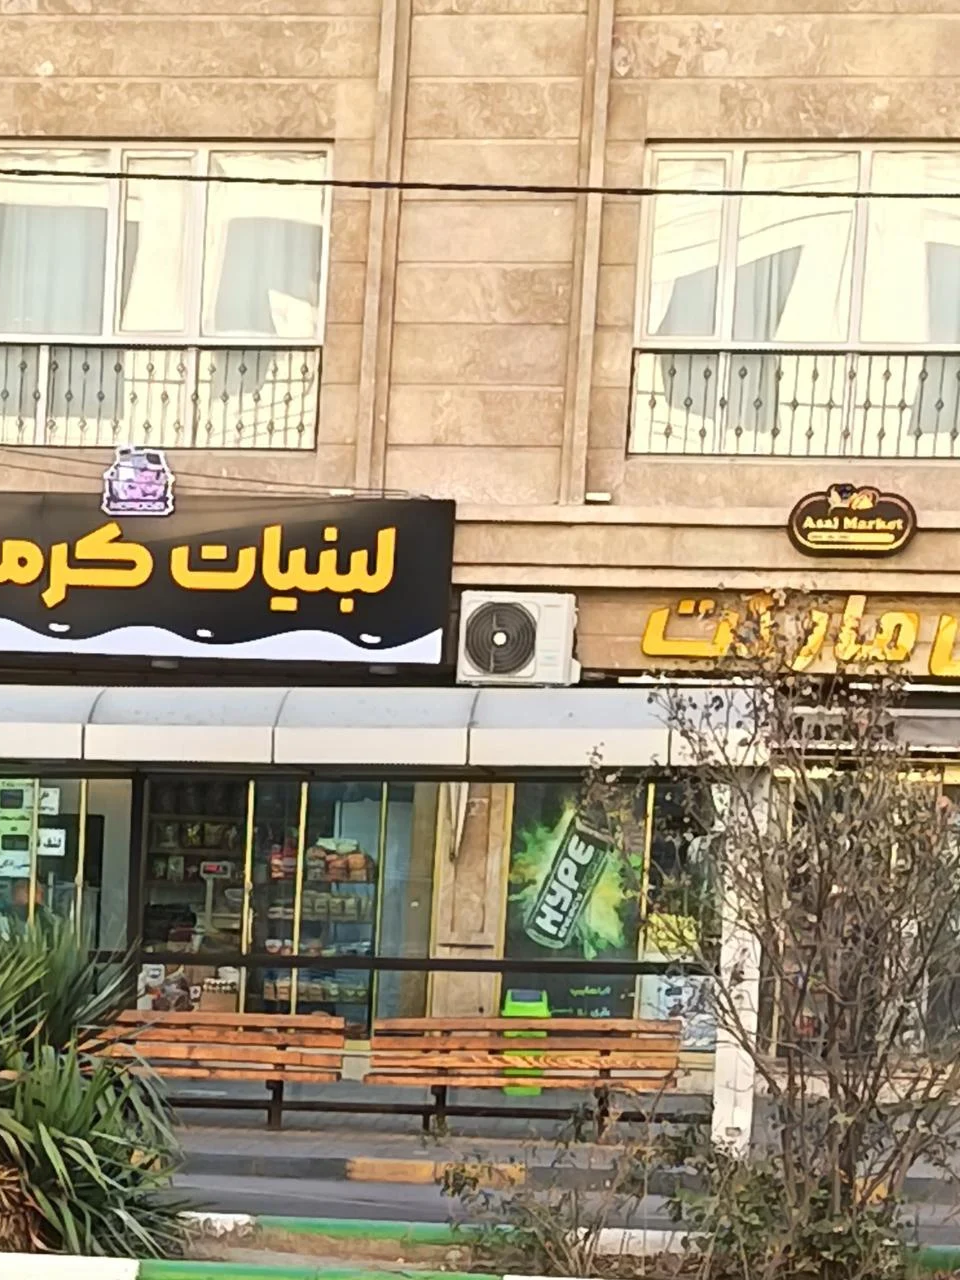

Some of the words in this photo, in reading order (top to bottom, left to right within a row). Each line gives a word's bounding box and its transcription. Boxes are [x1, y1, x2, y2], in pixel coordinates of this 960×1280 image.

[843, 516, 903, 531] Market
[171, 524, 397, 614] لبنیات
[535, 834, 595, 936] HYPE
